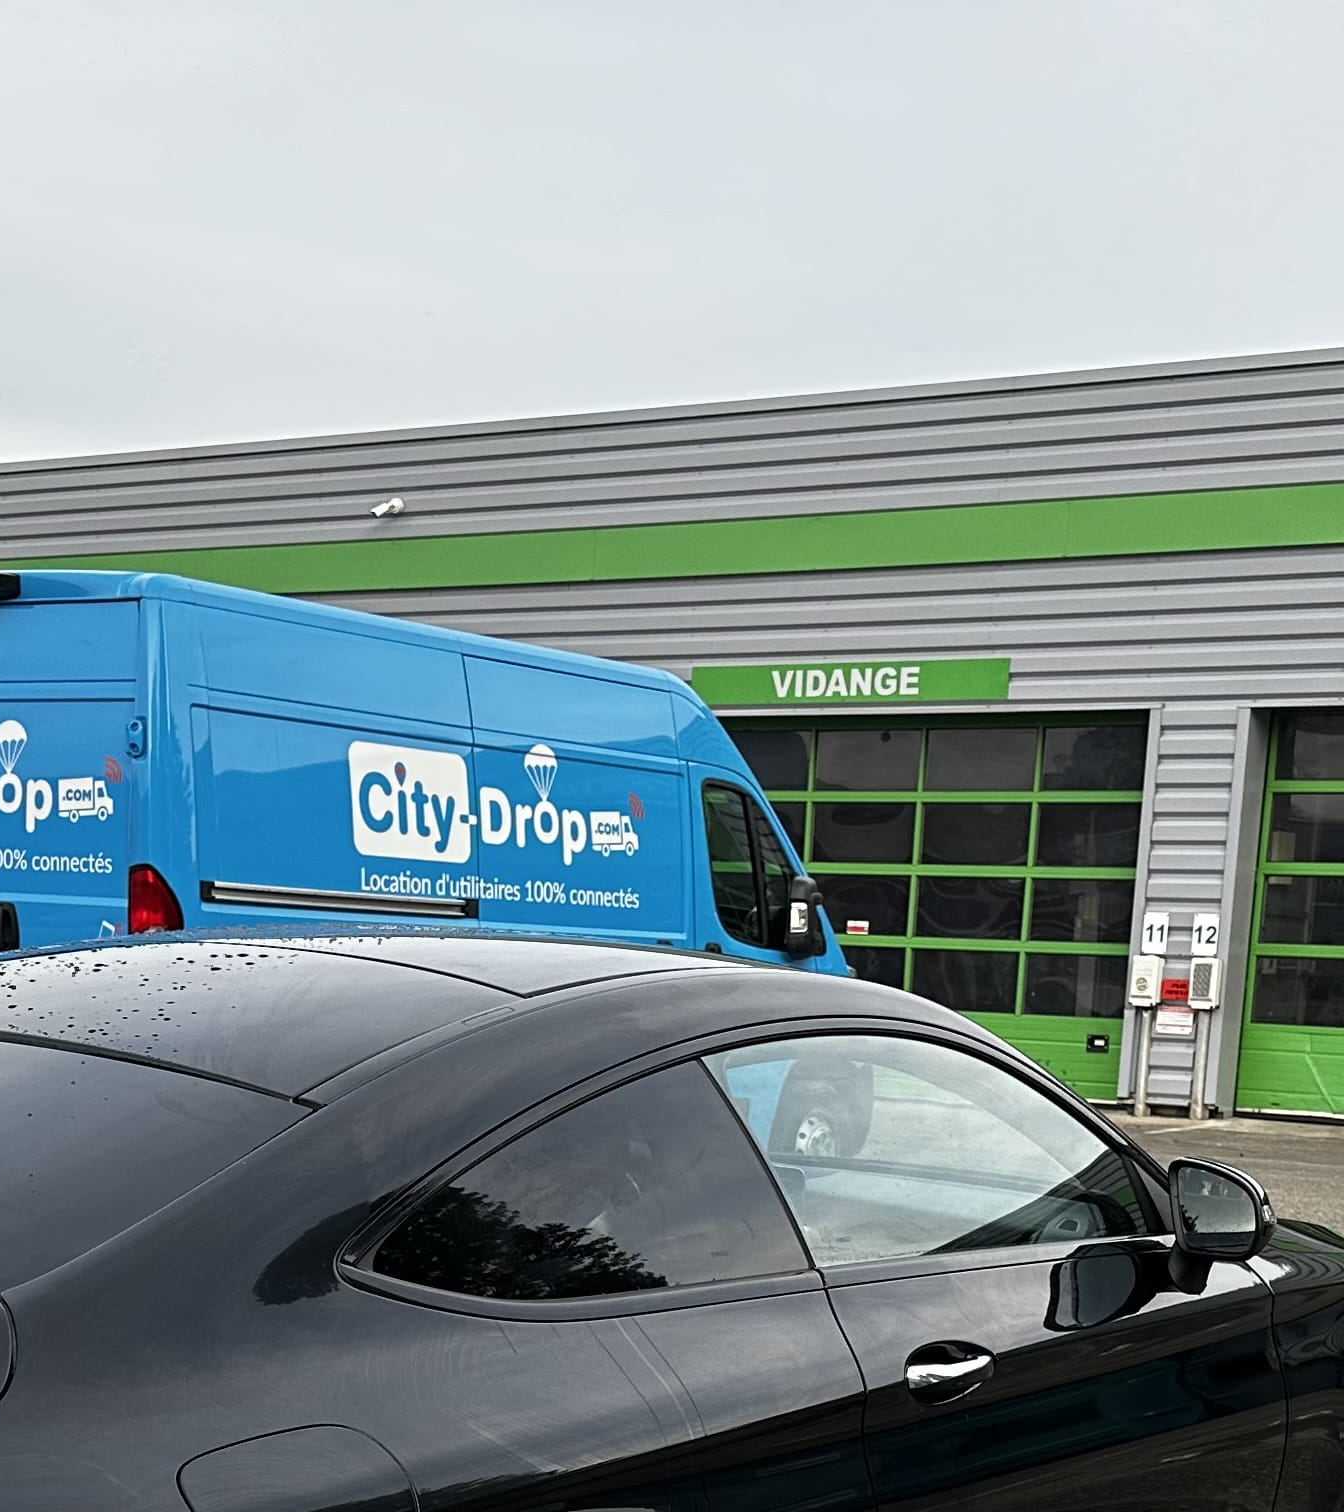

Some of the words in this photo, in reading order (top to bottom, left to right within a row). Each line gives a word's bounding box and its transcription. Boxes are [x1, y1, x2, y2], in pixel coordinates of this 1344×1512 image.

[771, 666, 921, 698] VIDANGE
[32, 852, 112, 873] connectés
[360, 867, 431, 896] Location
[436, 873, 521, 901] d'utilitaires
[525, 881, 566, 904] 100%
[570, 887, 639, 909] connectés
[1145, 924, 1165, 942] 11
[1194, 925, 1217, 944] 12
